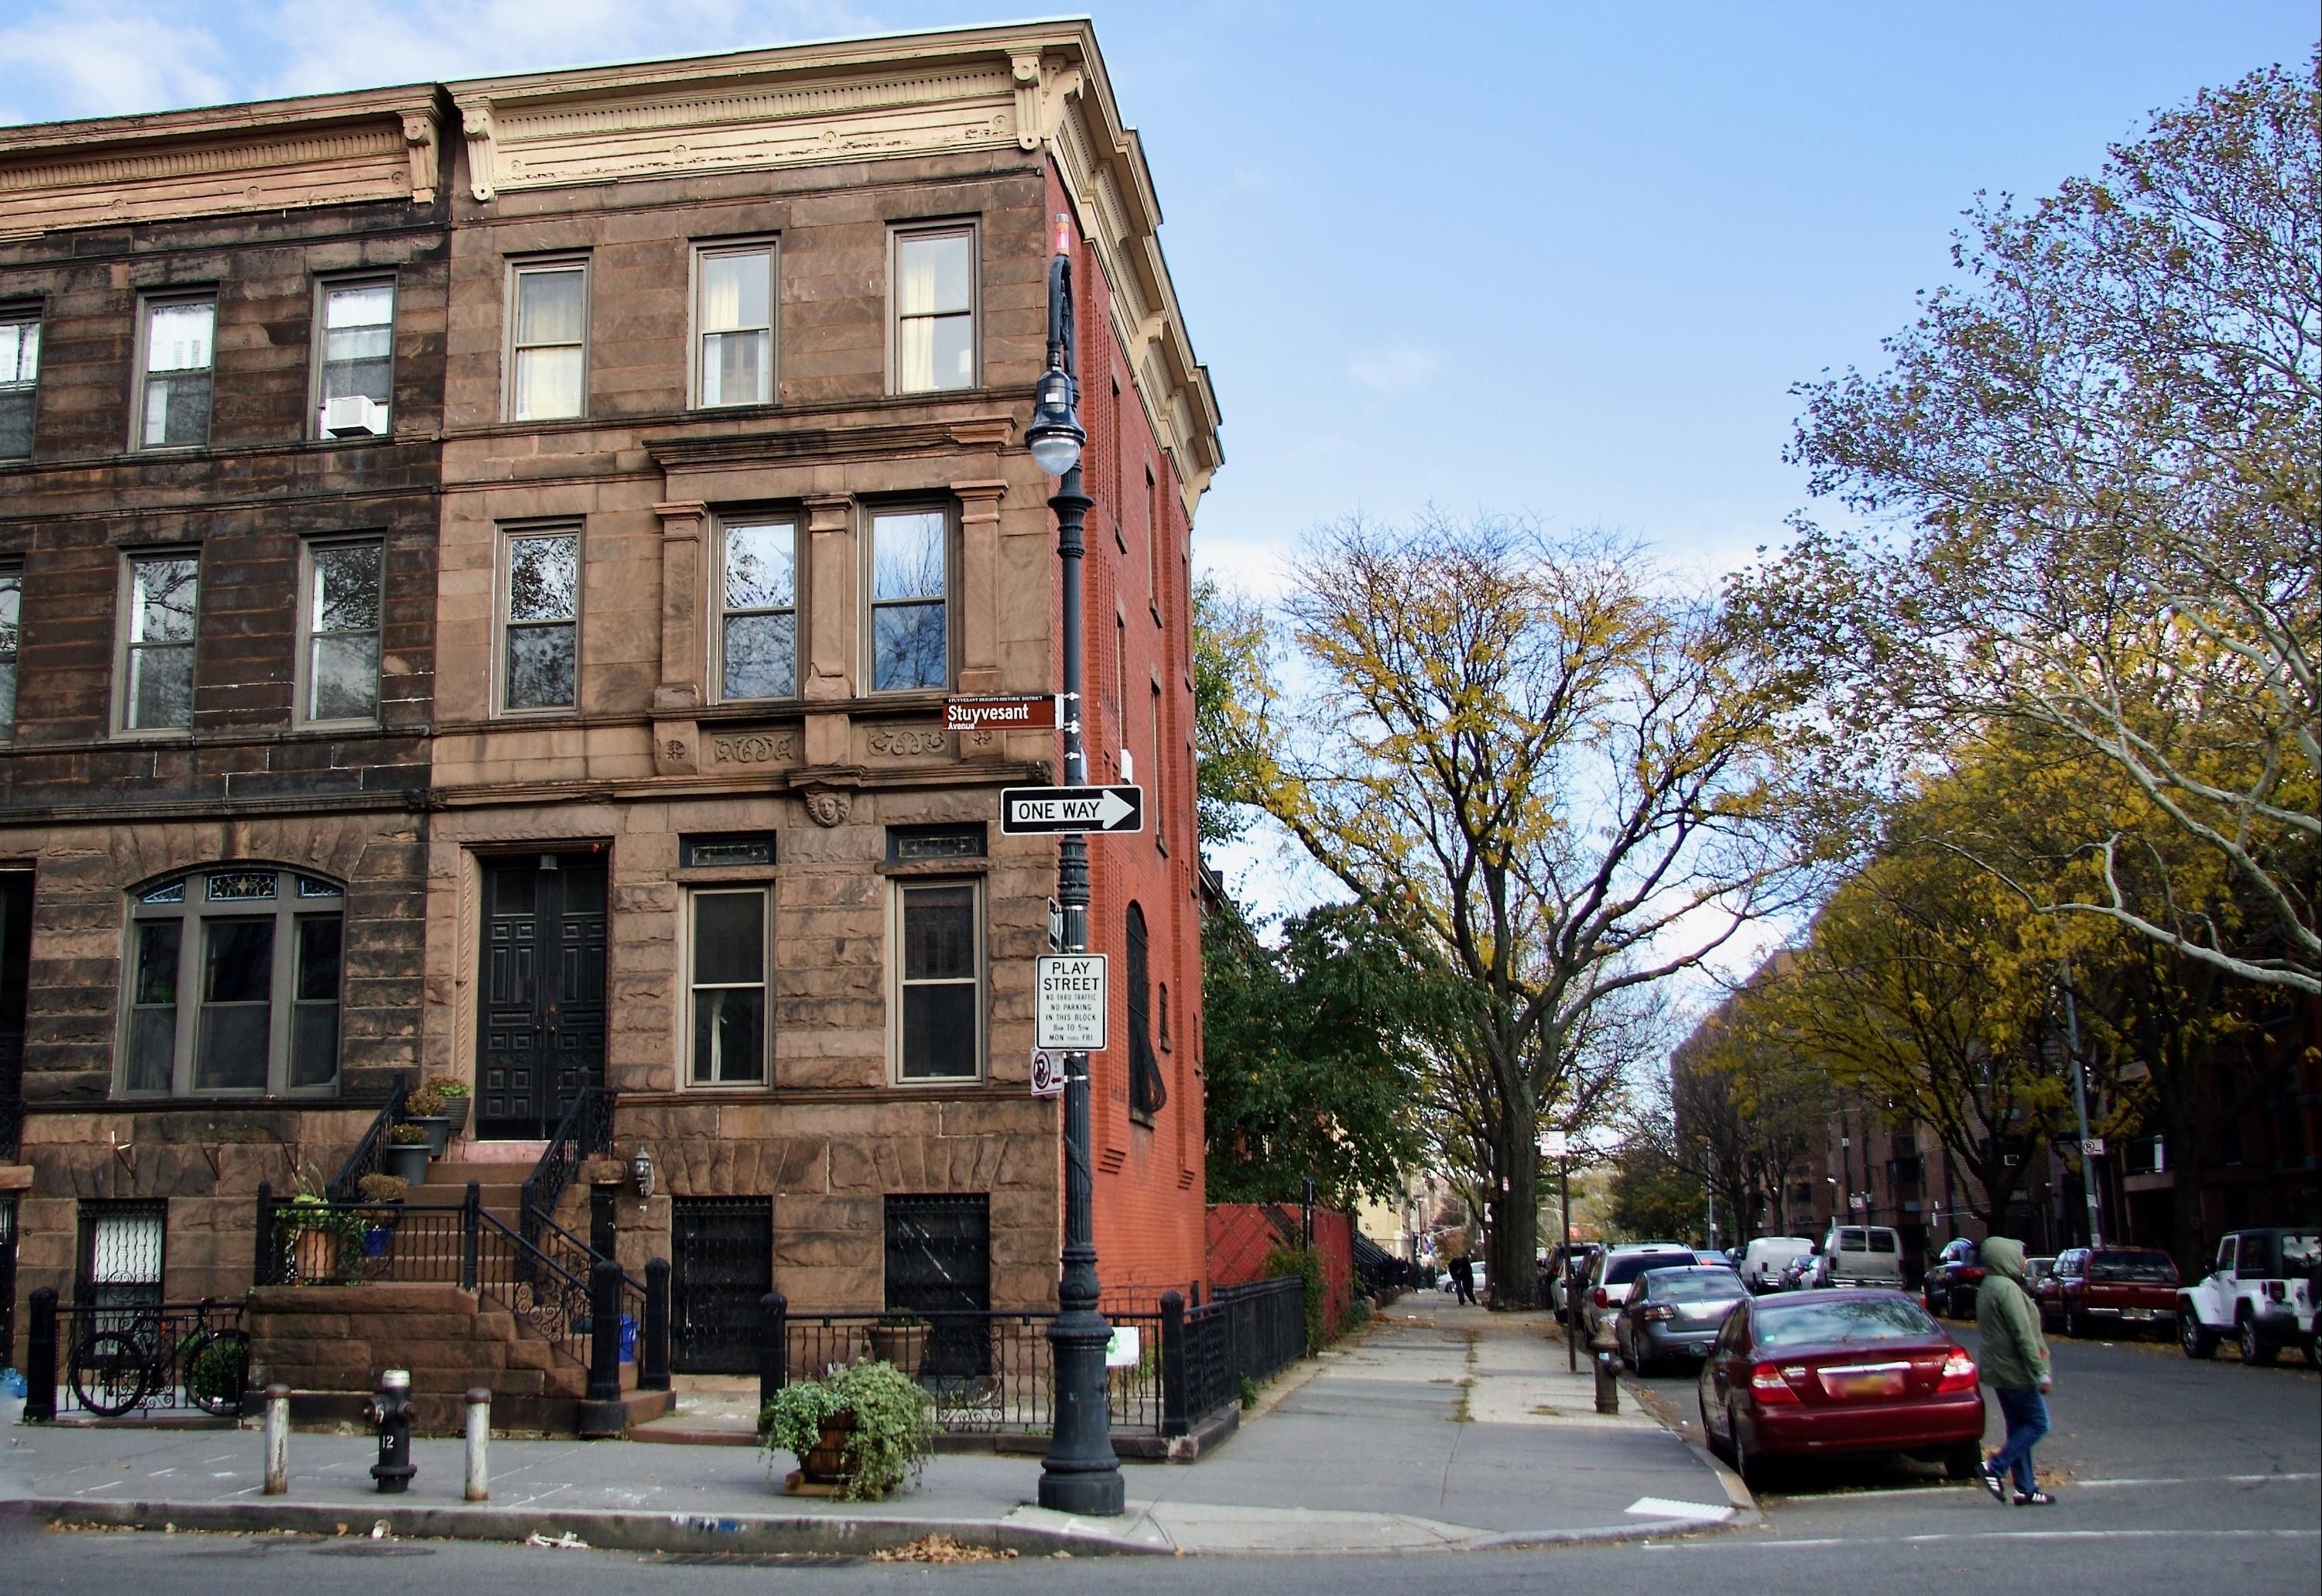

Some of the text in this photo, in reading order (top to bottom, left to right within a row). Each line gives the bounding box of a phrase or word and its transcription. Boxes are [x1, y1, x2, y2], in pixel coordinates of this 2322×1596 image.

[947, 703, 1029, 724] Stuyvesant
[947, 721, 975, 730] Avenue
[1019, 801, 1101, 820] ONE WAY
[1053, 961, 1090, 974] PLAY
[1043, 978, 1100, 991] STREET
[382, 1434, 394, 1449] 12
